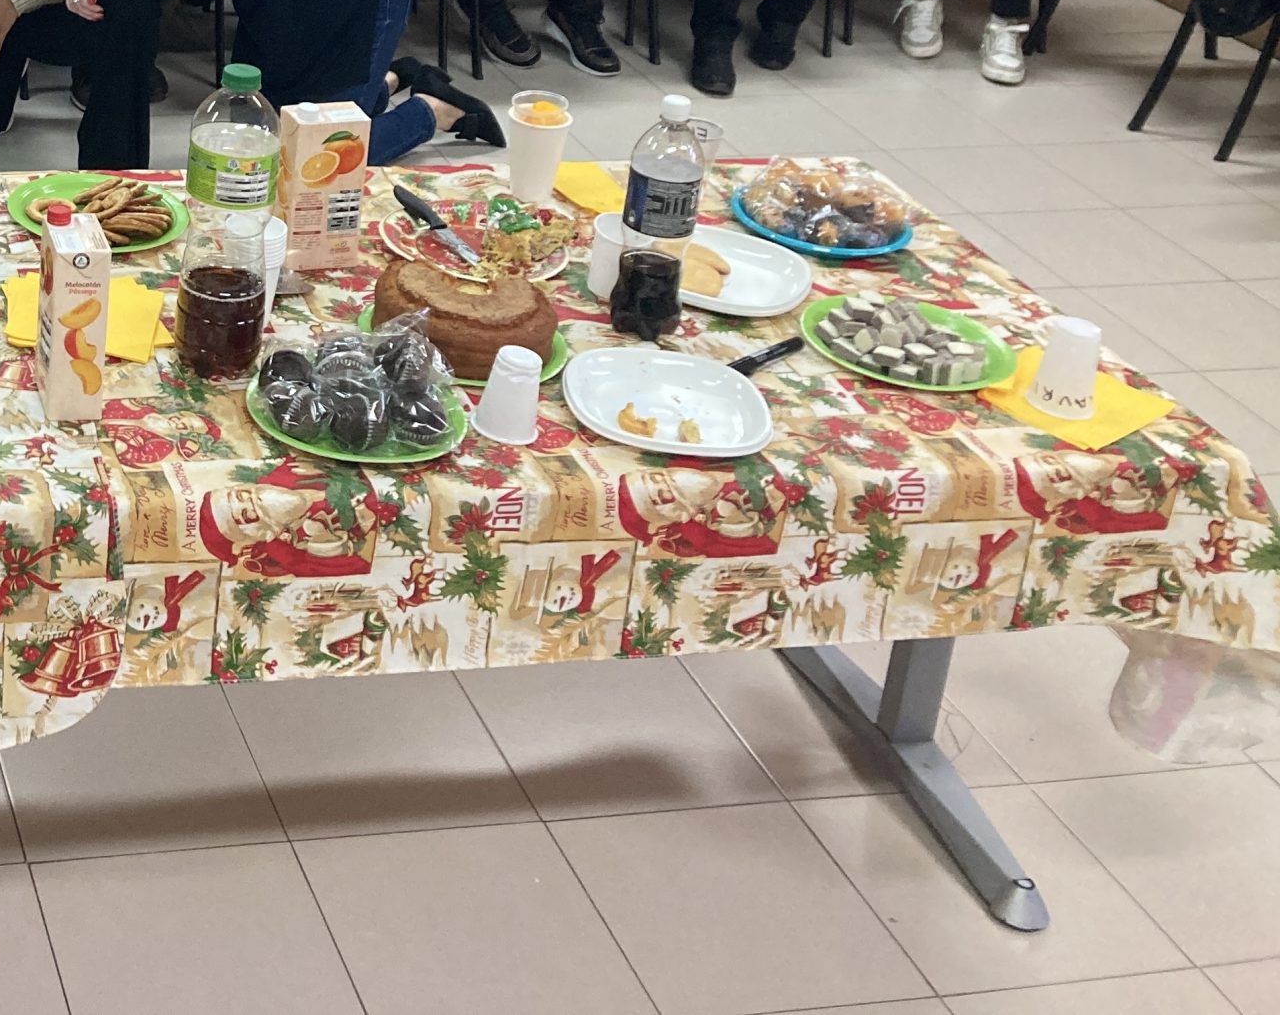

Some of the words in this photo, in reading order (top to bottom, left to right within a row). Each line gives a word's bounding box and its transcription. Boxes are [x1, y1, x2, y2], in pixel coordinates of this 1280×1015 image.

[488, 486, 524, 537] NOEL
[602, 482, 616, 518] MERRY
[891, 468, 926, 519] NOEL
[151, 502, 175, 548] Merry
[185, 498, 197, 538] MERRY
[181, 541, 196, 552] A
